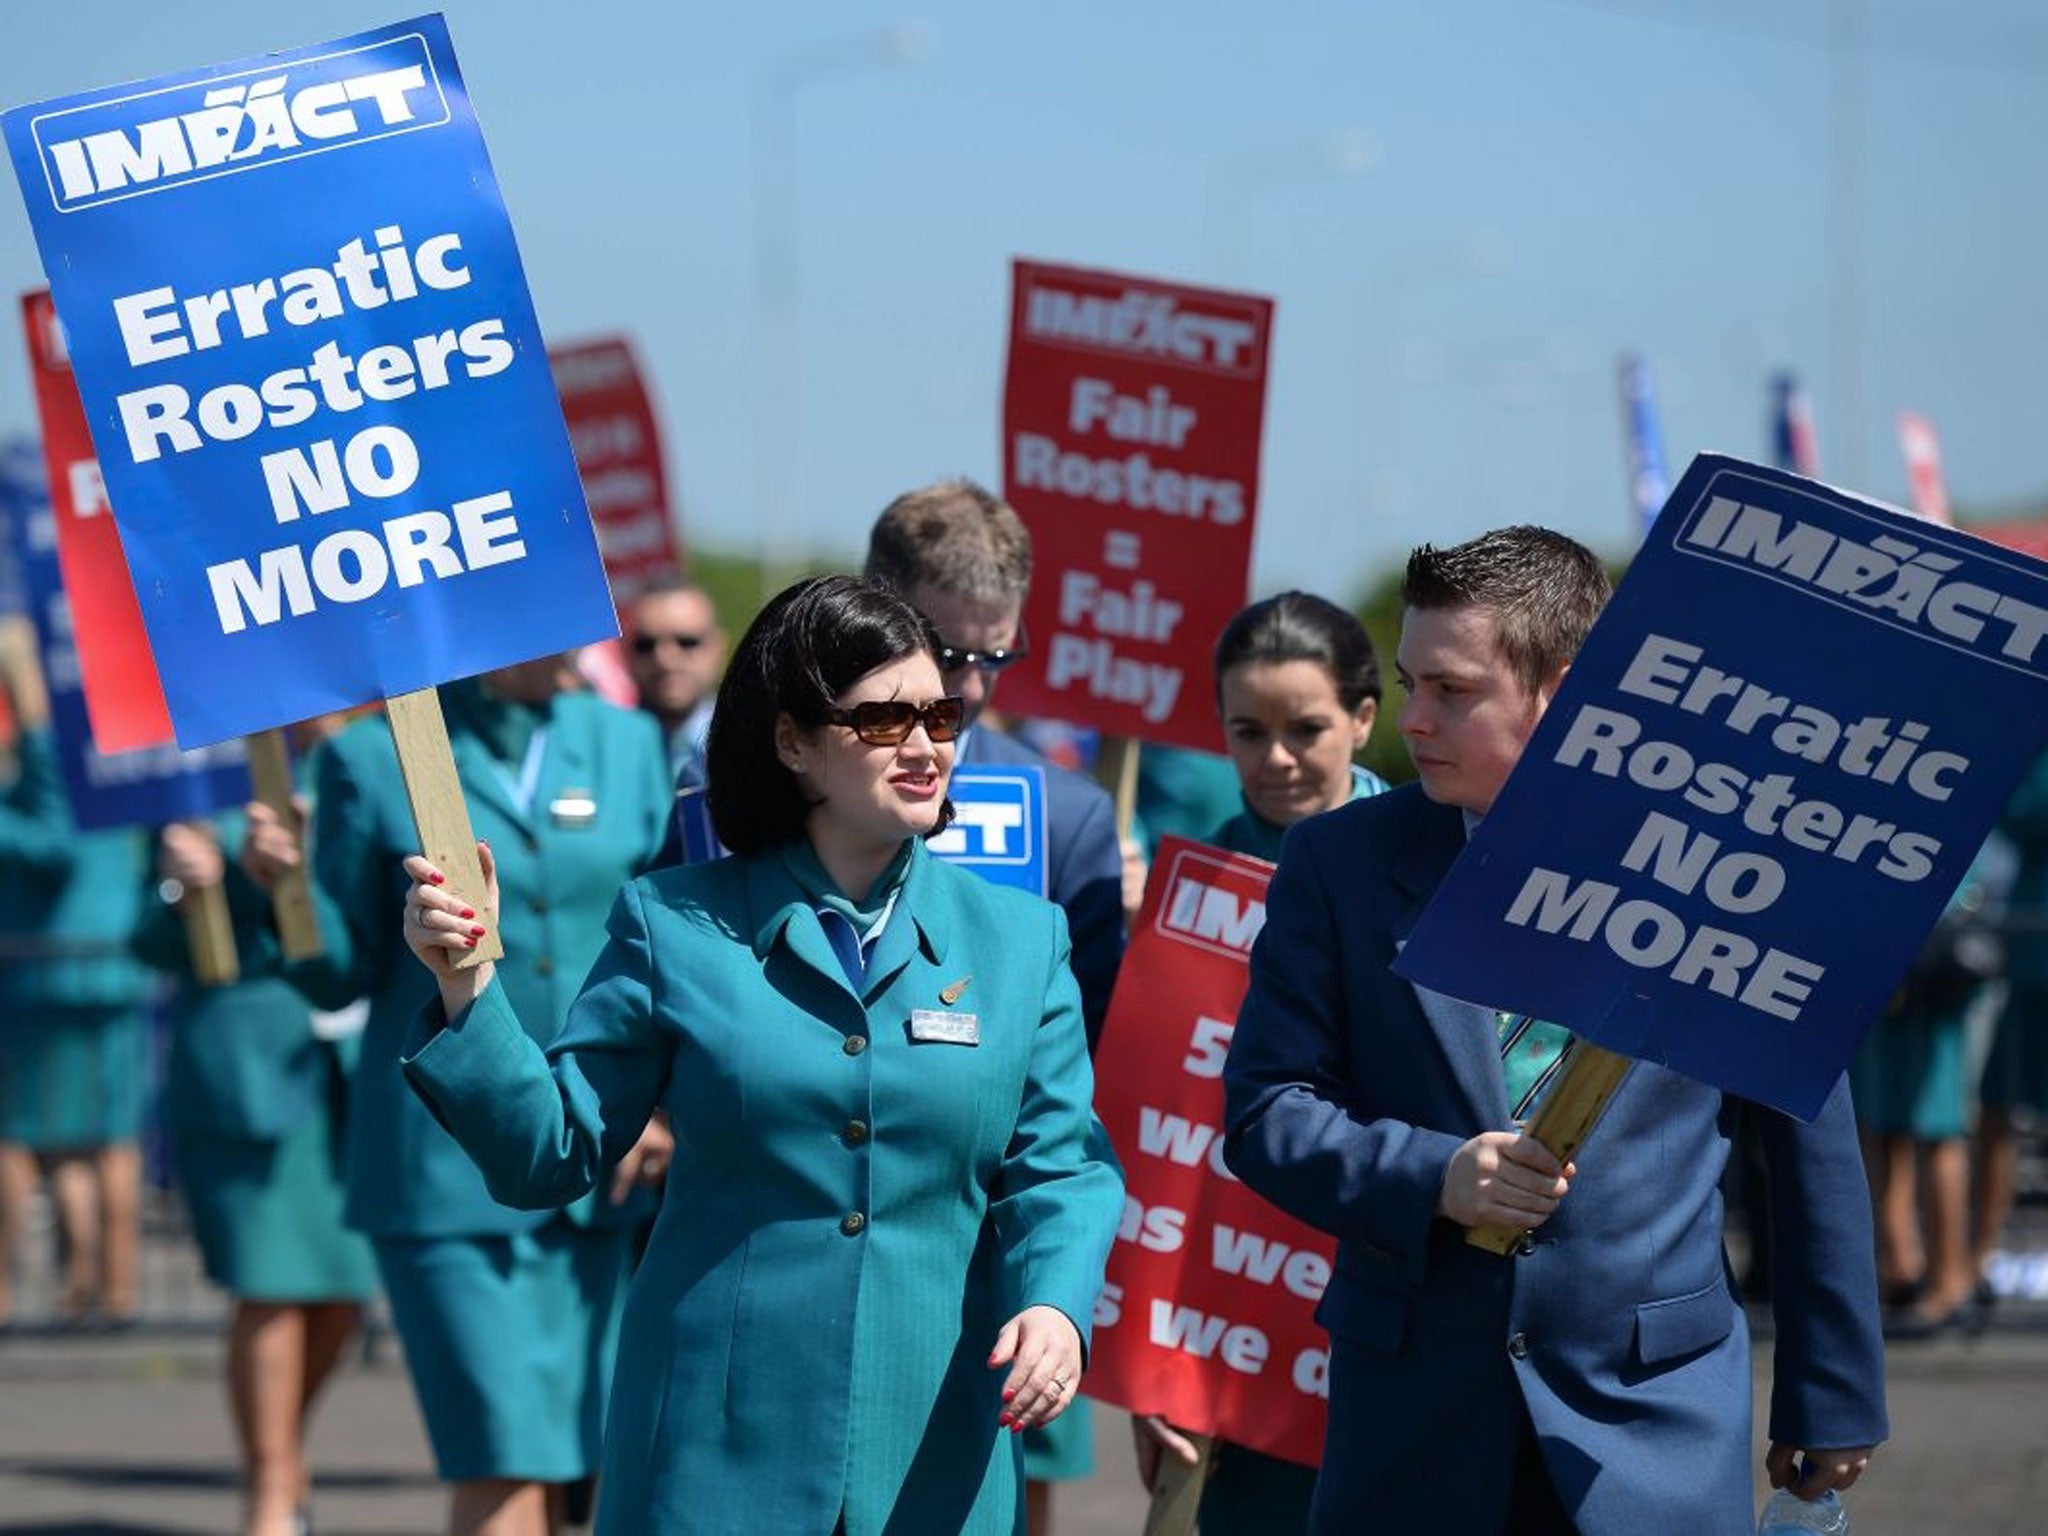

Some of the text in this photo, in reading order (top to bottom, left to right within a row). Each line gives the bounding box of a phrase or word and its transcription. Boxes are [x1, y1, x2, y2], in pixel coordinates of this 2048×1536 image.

[48, 64, 425, 200] IMPACT
[113, 225, 470, 366] Erratic
[1028, 289, 1255, 366] IMPACT
[116, 319, 514, 463] Rosters
[1069, 376, 1196, 448] Fair
[261, 426, 420, 523] NO
[1015, 432, 1245, 524] Rosters
[207, 490, 527, 635] MORE
[1060, 570, 1183, 643] Fair
[1687, 496, 2048, 660] IMPACT
[1047, 634, 1184, 723] Play
[1618, 633, 1969, 801] Erratic
[1553, 705, 1942, 881] Rosters
[1621, 811, 1786, 914] NO
[1505, 867, 1825, 1021] MORE
[1212, 1224, 1331, 1300] we
[1150, 1298, 1268, 1375] we
